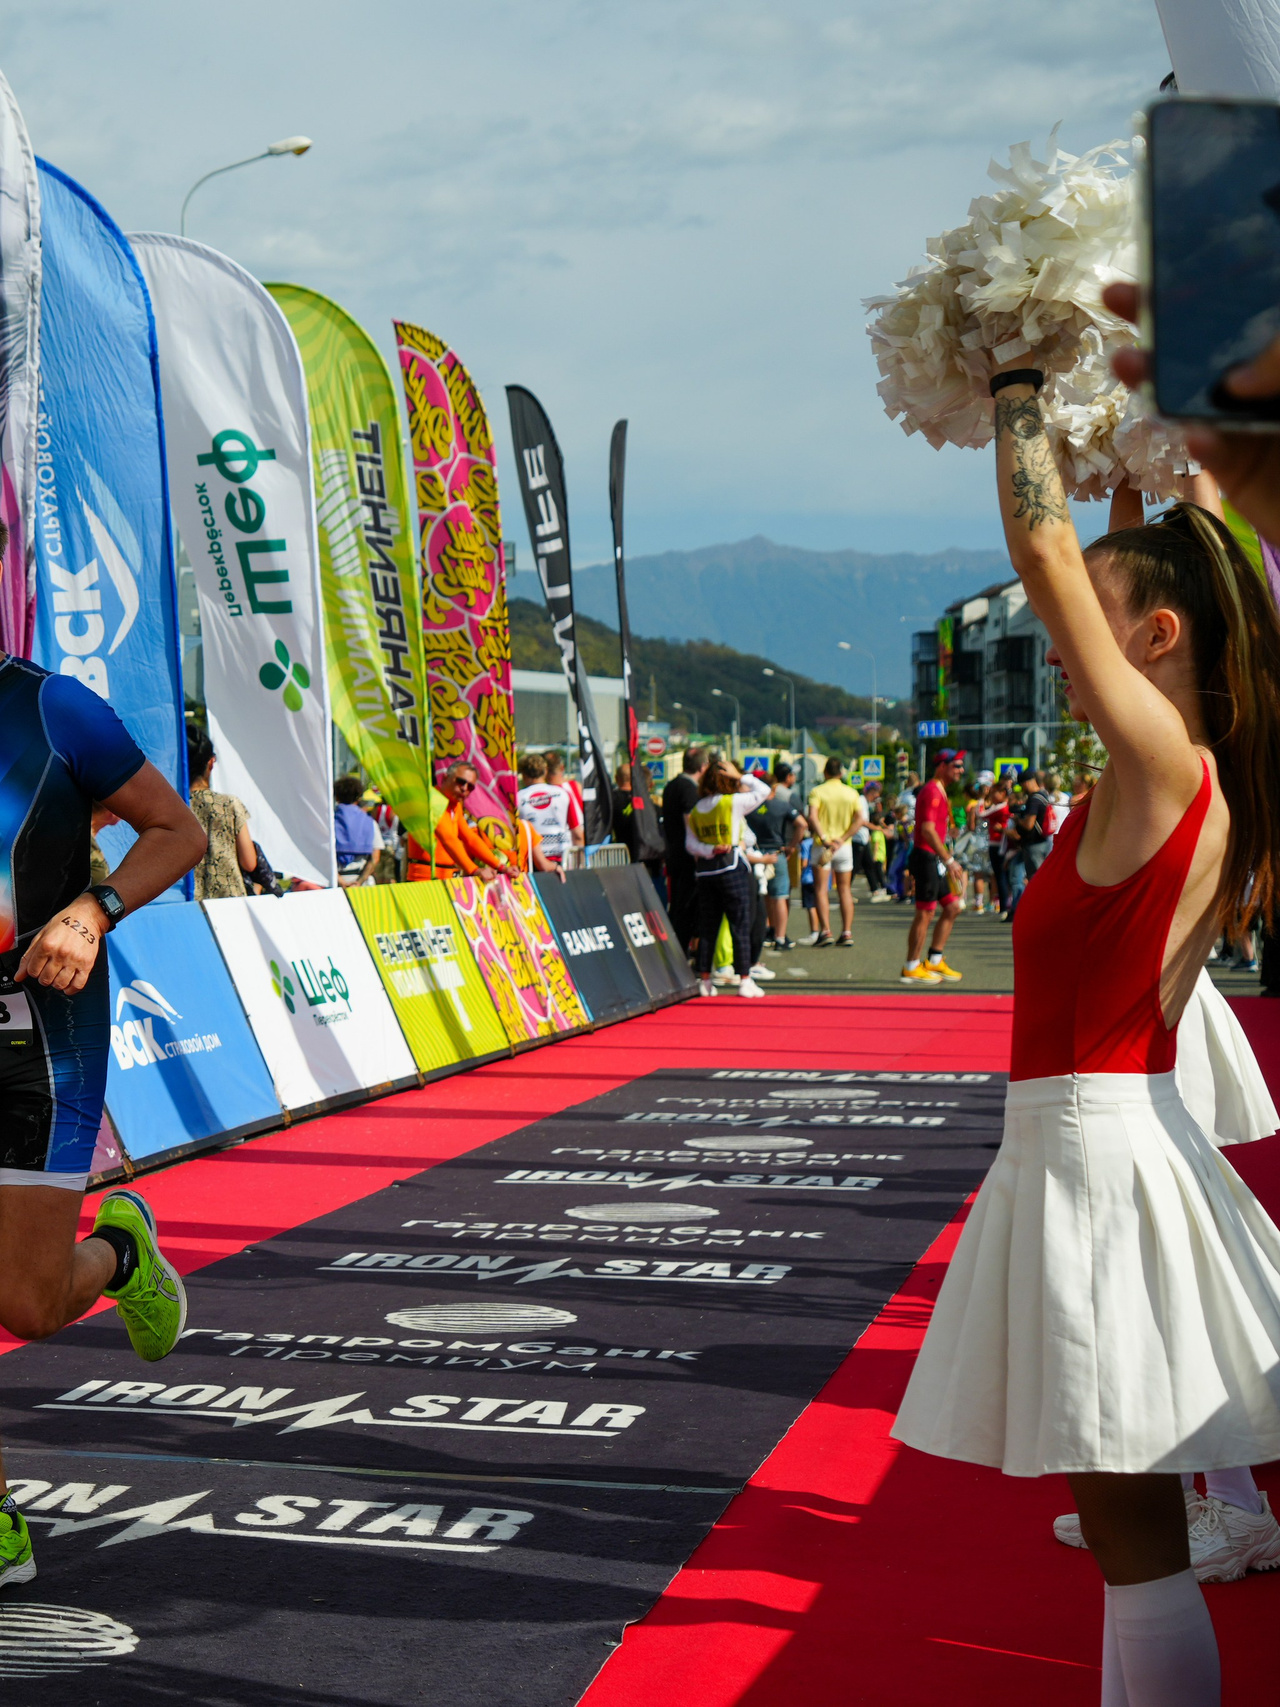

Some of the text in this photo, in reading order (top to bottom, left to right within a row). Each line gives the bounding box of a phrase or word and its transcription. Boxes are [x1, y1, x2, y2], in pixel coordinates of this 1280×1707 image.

[61, 916, 96, 945] 4223
[374, 925, 458, 965] FAHRENHEIT
[291, 956, 352, 1012] Шеф
[110, 1017, 168, 1071] ВСК
[710, 1071, 992, 1082] IRON STAR
[624, 1112, 947, 1126] IRON STAR
[504, 1169, 884, 1189] IRON STAR
[401, 1219, 827, 1240] Газпромбанк
[451, 1229, 746, 1247] Премиум
[330, 1251, 794, 1281] IRON STAR
[178, 1328, 705, 1361] Газпромбанк
[228, 1345, 598, 1373] Премиум
[60, 1379, 647, 1430] IRON STAR
[234, 1494, 536, 1543] STAR
